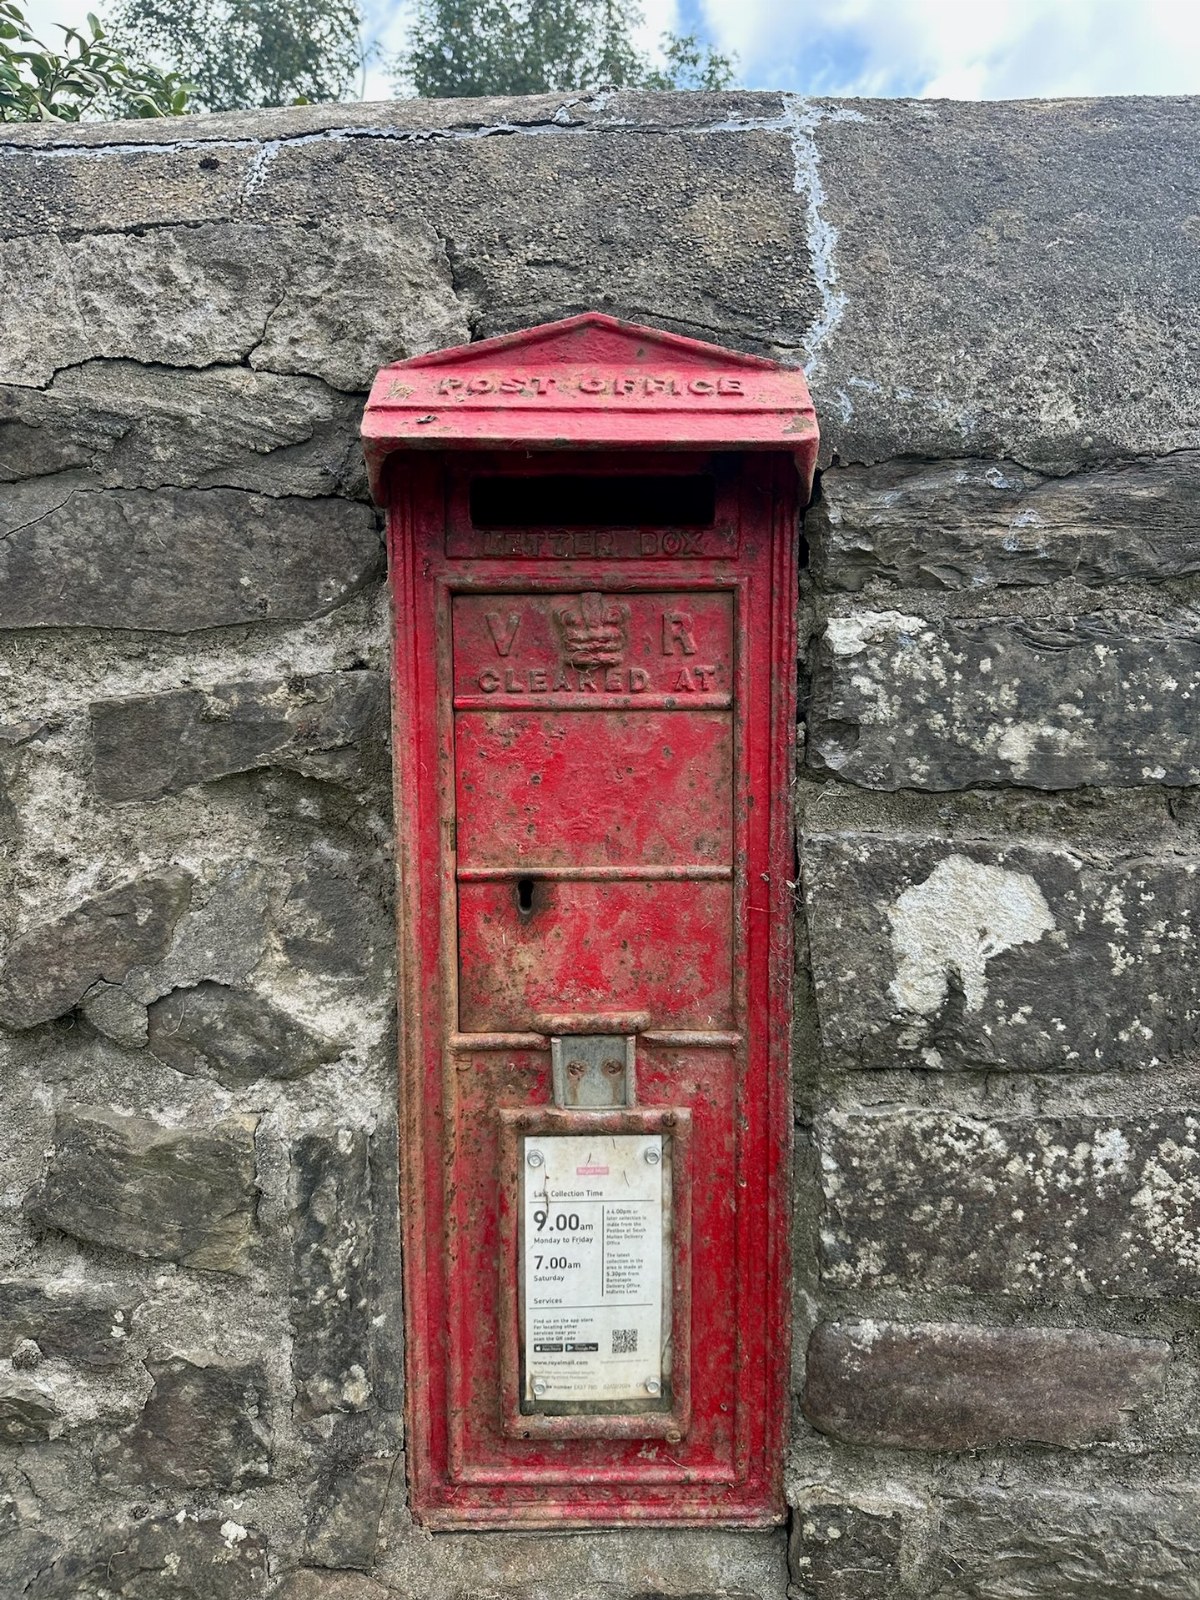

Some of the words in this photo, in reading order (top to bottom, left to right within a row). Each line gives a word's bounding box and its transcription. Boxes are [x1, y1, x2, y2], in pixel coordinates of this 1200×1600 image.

[437, 376, 556, 396] POST
[578, 376, 745, 397] OFFICE
[482, 530, 614, 556] LETTER
[639, 531, 705, 556] BOX
[485, 612, 522, 657] V
[662, 610, 697, 656] R
[478, 667, 650, 693] CLEARED
[673, 665, 716, 692] AT
[551, 1189, 585, 1197] Collection
[586, 1189, 604, 1197] Time
[533, 1210, 594, 1231] 9.00am
[533, 1237, 560, 1245] Monday
[571, 1235, 594, 1244] Friday
[533, 1255, 581, 1270] 7.00am
[533, 1274, 565, 1283] Saturday
[533, 1297, 563, 1305] Services
